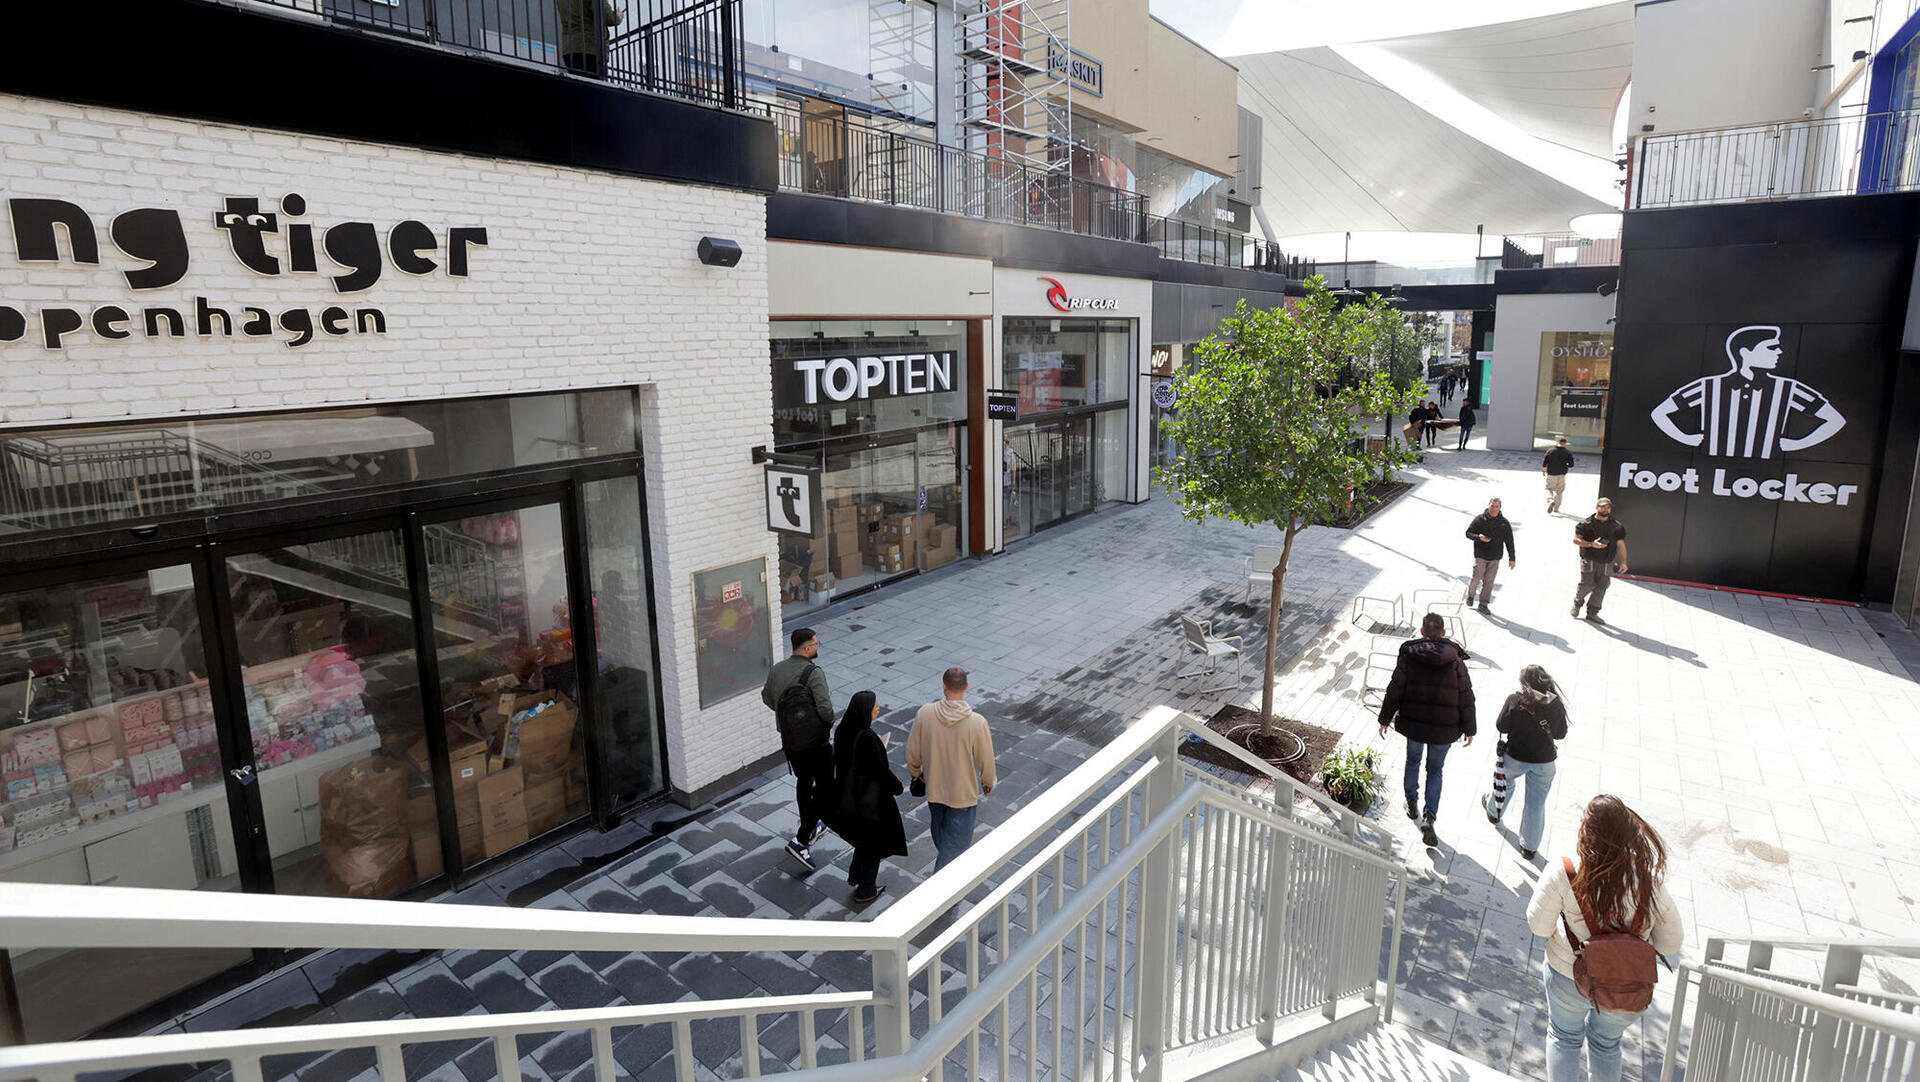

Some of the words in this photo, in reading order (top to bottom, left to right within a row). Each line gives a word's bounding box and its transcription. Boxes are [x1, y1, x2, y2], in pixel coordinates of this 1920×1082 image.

[213, 192, 488, 294] tiger
[1551, 346, 1608, 357] OYSHO
[793, 353, 951, 404] TOPTEN
[989, 404, 1016, 413] TOPTEN
[1619, 462, 1699, 494] Foot
[1712, 468, 1858, 506] Locker
